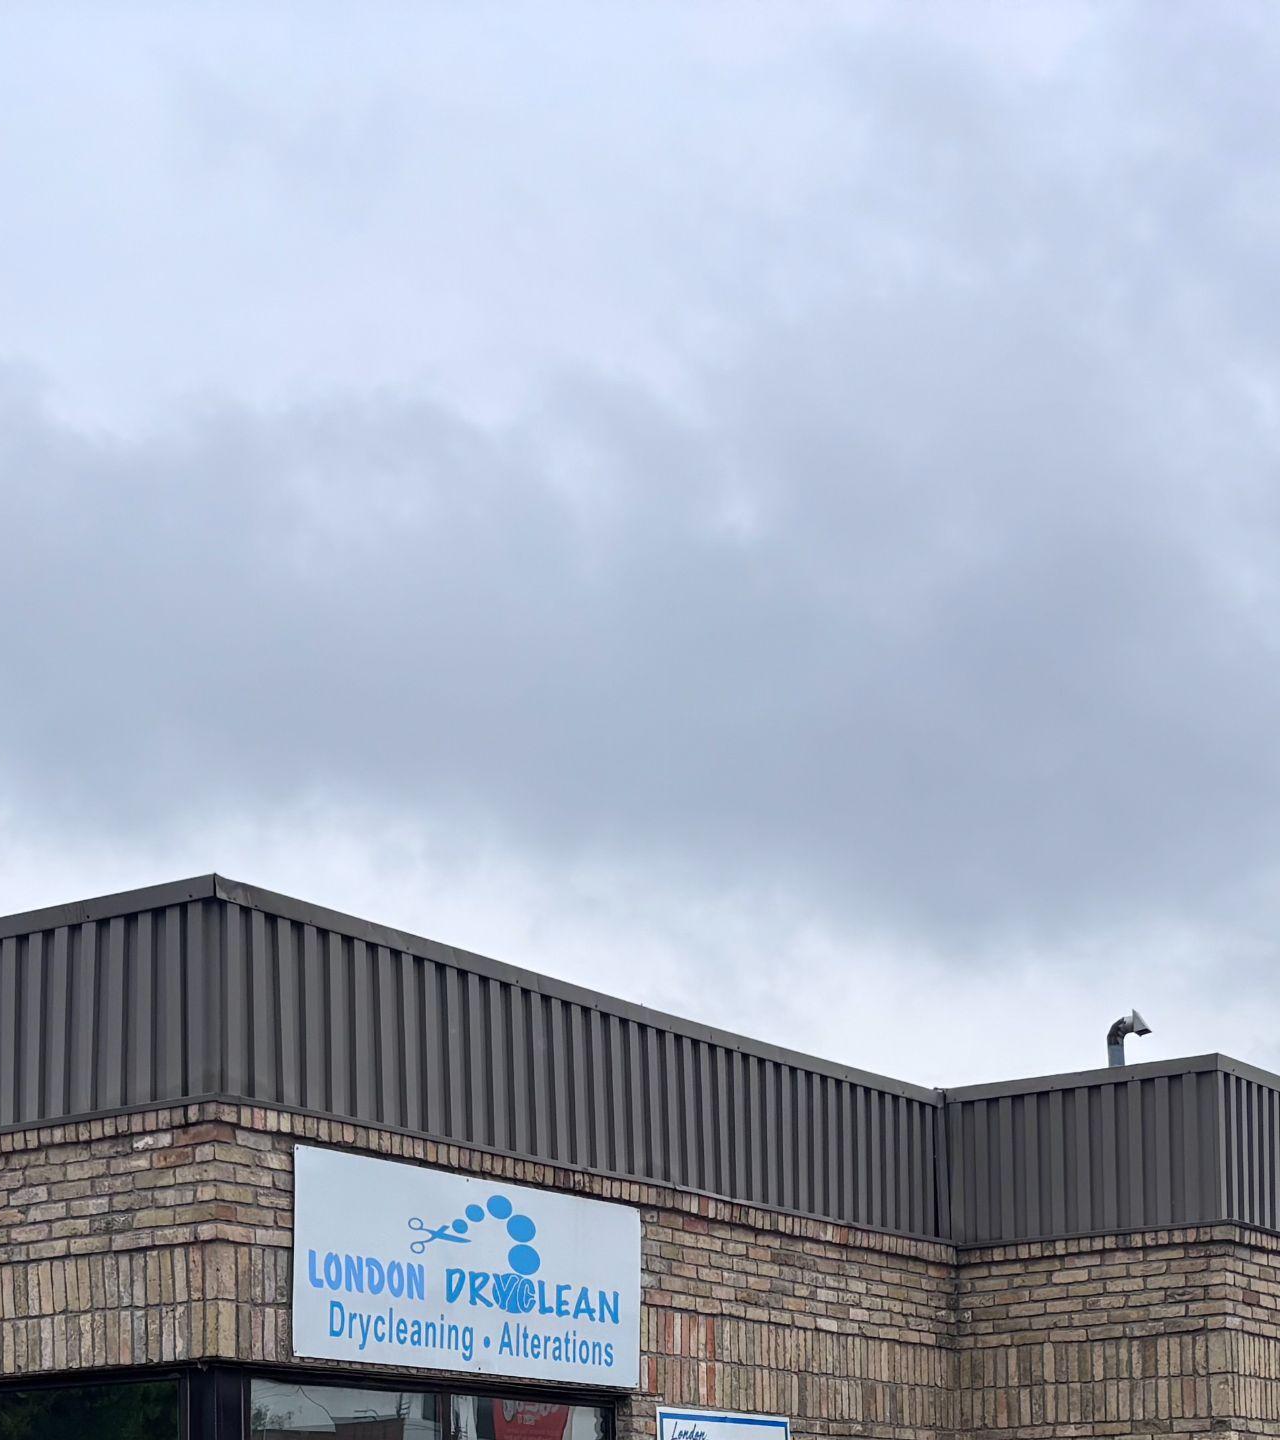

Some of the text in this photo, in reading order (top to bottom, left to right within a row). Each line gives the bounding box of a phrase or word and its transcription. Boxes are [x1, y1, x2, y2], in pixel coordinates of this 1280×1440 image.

[308, 1249, 620, 1325] LONDON DRYCLEAN
[329, 1300, 614, 1368] Drycleaning Alterations
